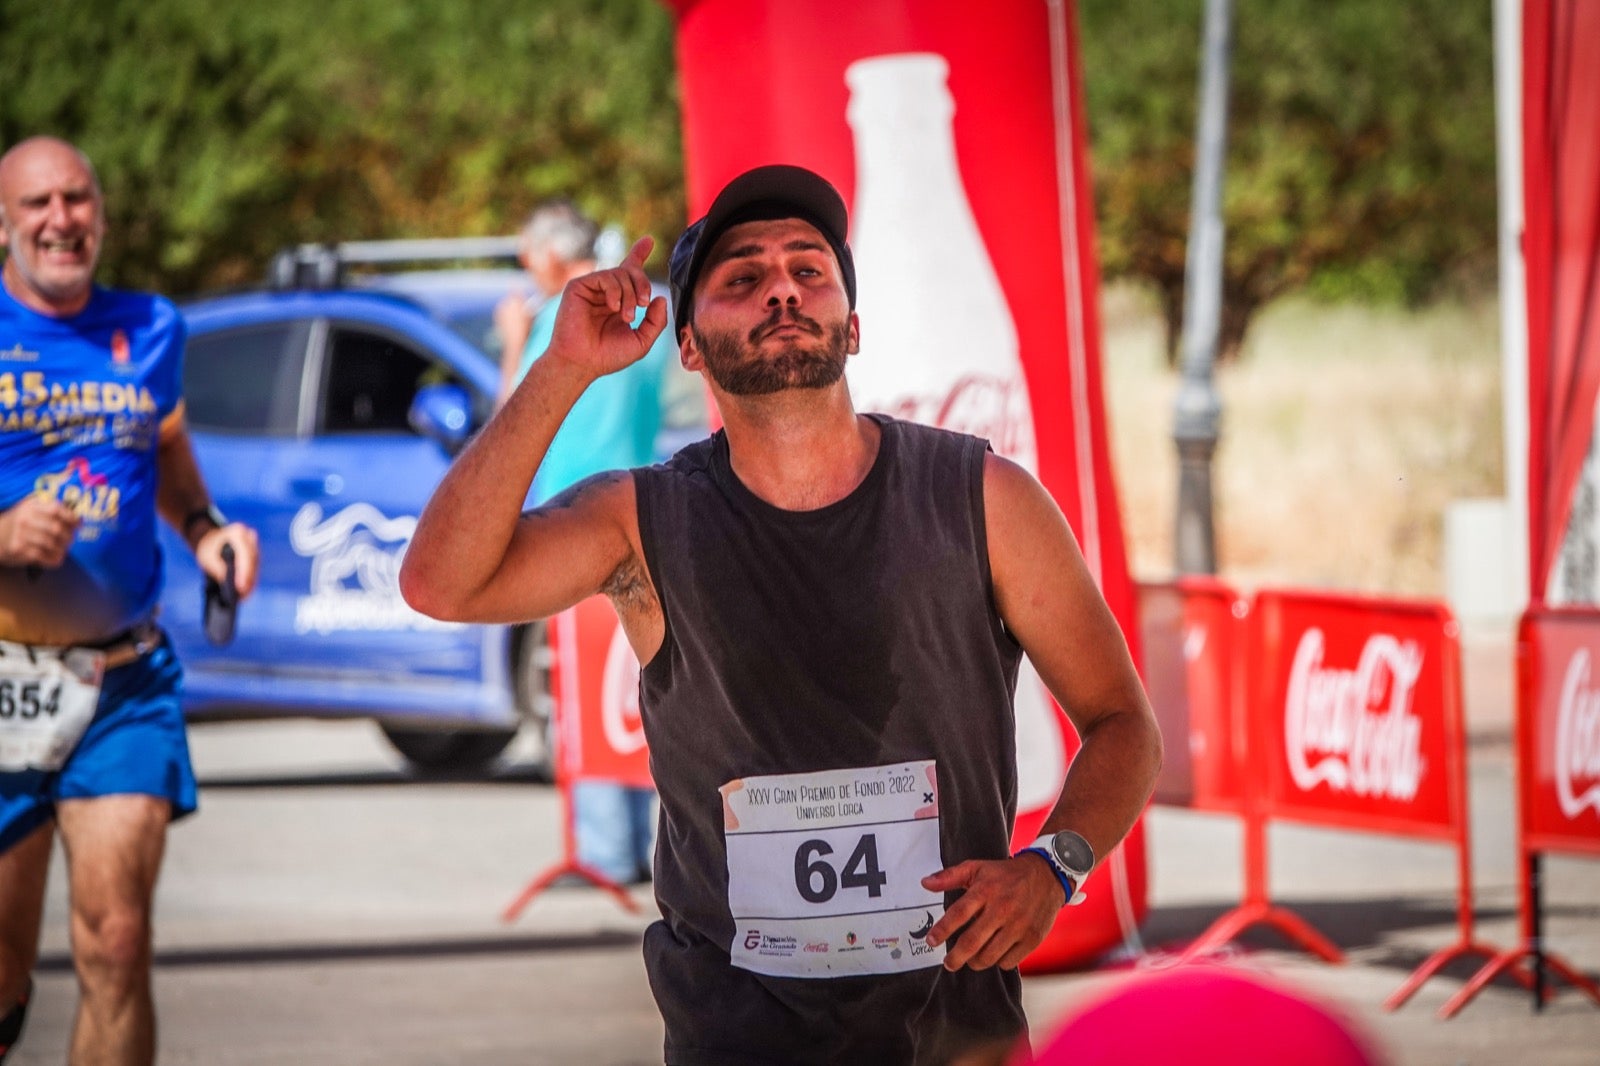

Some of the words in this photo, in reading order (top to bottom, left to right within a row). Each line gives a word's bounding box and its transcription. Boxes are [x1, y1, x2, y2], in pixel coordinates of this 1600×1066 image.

[49, 380, 156, 414] MEDIA
[747, 788, 771, 805] XXXV
[800, 784, 836, 801] PREMIO
[854, 780, 885, 797] FONDO
[889, 775, 916, 794] 2022
[796, 804, 836, 820] UNIVERSO
[794, 833, 887, 904] 64
